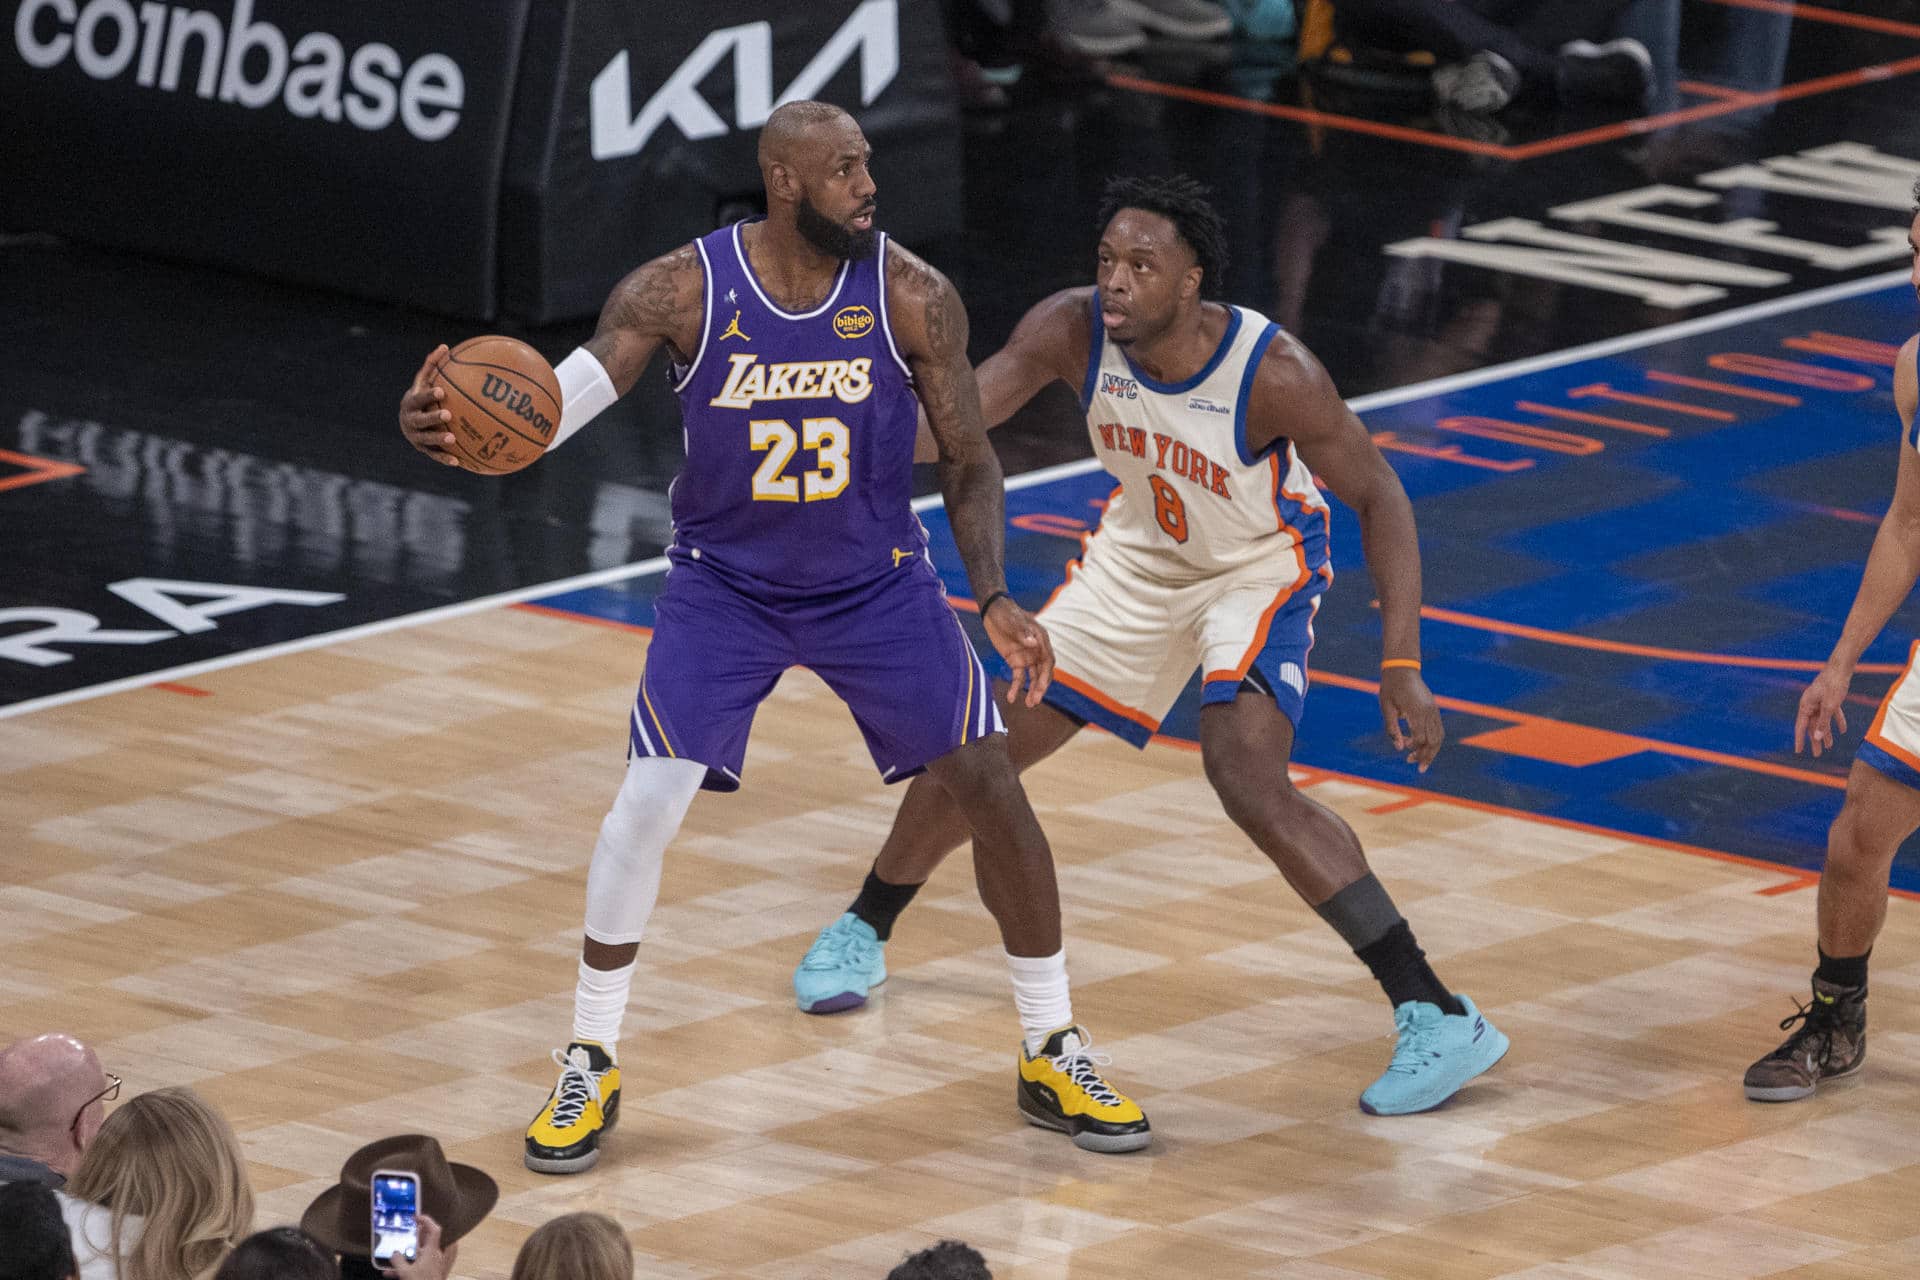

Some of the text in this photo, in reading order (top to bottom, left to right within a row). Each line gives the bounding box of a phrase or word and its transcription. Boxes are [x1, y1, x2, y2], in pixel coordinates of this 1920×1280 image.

[14, 0, 465, 142] coinbase
[837, 314, 872, 328] bibigo
[482, 373, 553, 438] Wilson
[1102, 373, 1138, 399] NYC
[749, 417, 851, 503] 23
[1098, 423, 1232, 500] NEW YORK
[1148, 473, 1188, 544] 8
